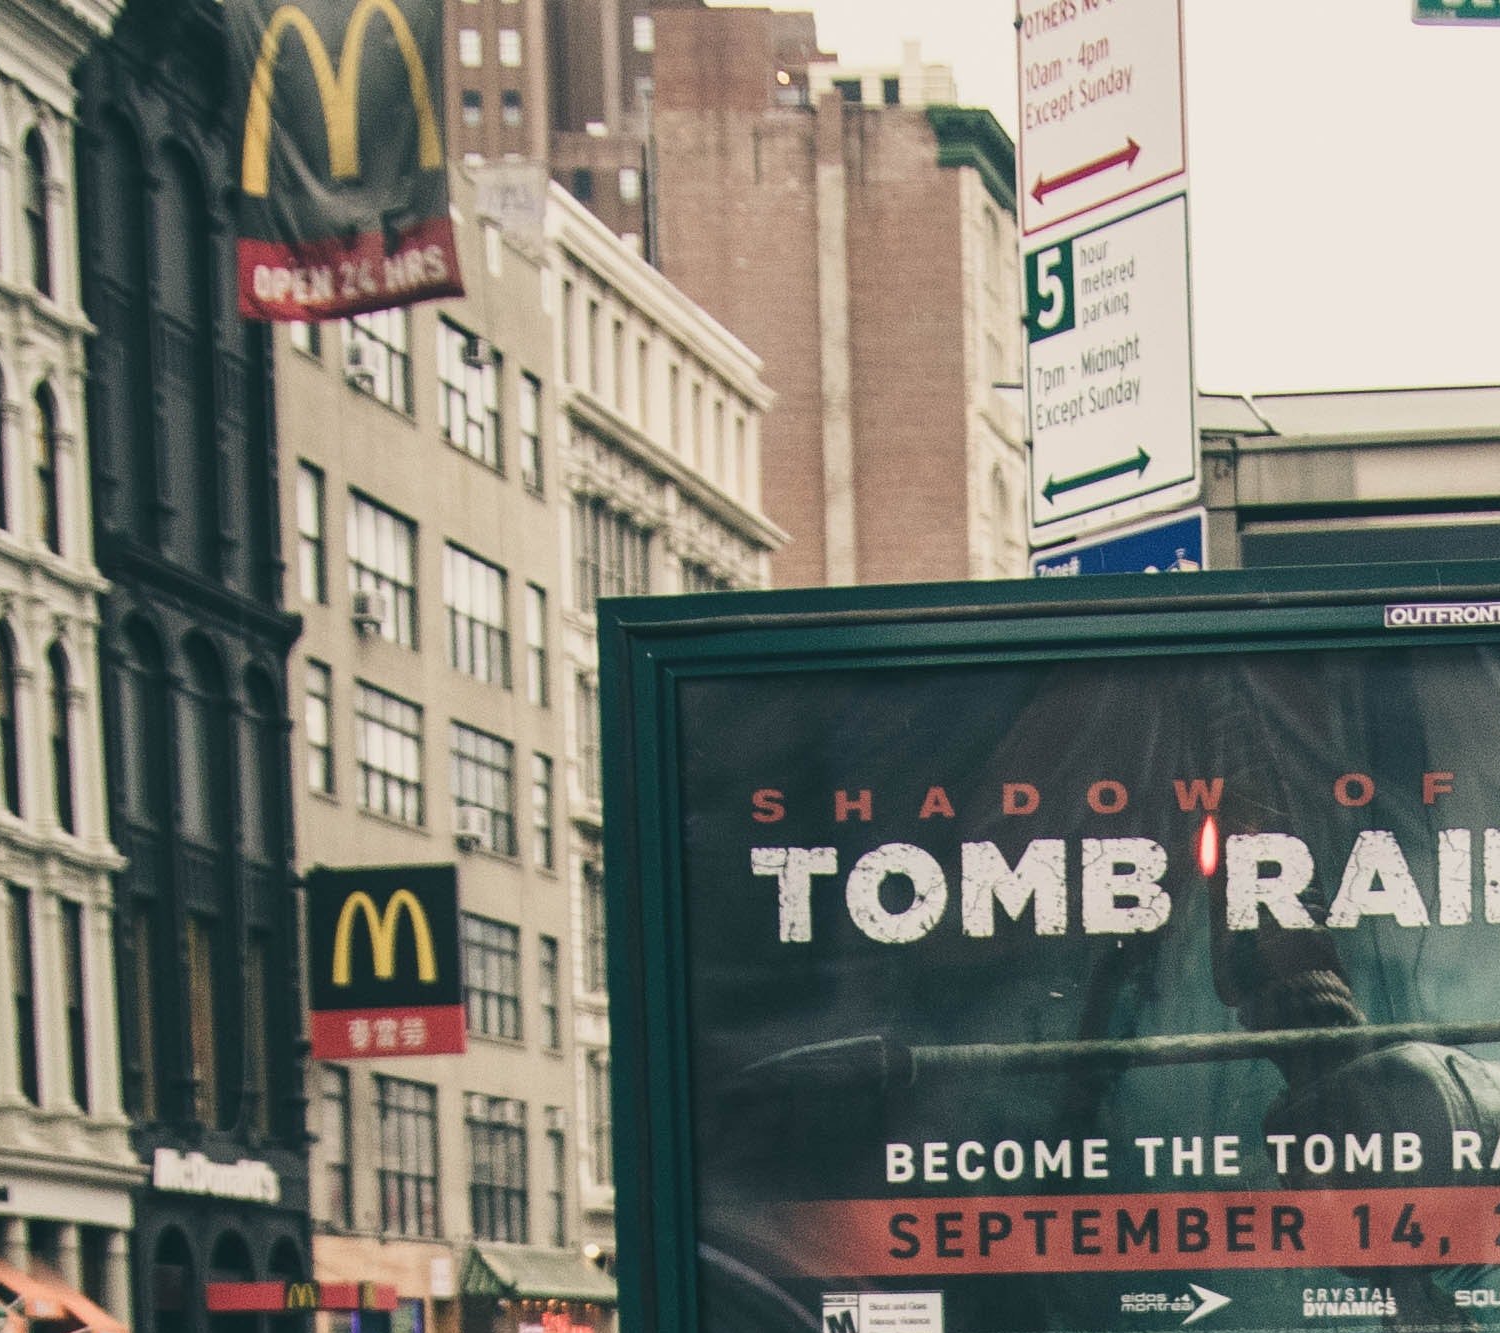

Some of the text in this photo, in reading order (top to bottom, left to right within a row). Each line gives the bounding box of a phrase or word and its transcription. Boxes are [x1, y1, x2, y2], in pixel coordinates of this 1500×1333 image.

[1024, 0, 1077, 40] OTHERS
[1025, 58, 1062, 92] 10am
[1077, 37, 1110, 71] 4pm
[1025, 64, 1133, 131] Except Sunday
[252, 245, 447, 303] OPEN 24 HRS
[1080, 239, 1108, 267] hour
[1081, 255, 1136, 296] metered
[1037, 246, 1065, 331] 5
[1082, 291, 1130, 329] parking
[1036, 364, 1065, 397] 7pm
[1081, 333, 1141, 377] Midnight
[1035, 375, 1142, 431] Except Sunday
[751, 777, 1224, 823] SHADOW
[1334, 771, 1454, 806] OF
[750, 836, 1172, 944] TOMB
[886, 1138, 1109, 1182] BECOME
[1135, 1135, 1241, 1178] THE
[1267, 1131, 1422, 1174] TOMB
[889, 1205, 1306, 1259] SEPTEMBER
[1352, 1203, 1453, 1257] 14,
[1303, 1287, 1396, 1302] CRYSTAL
[1303, 1301, 1397, 1317] DYNAMICS
